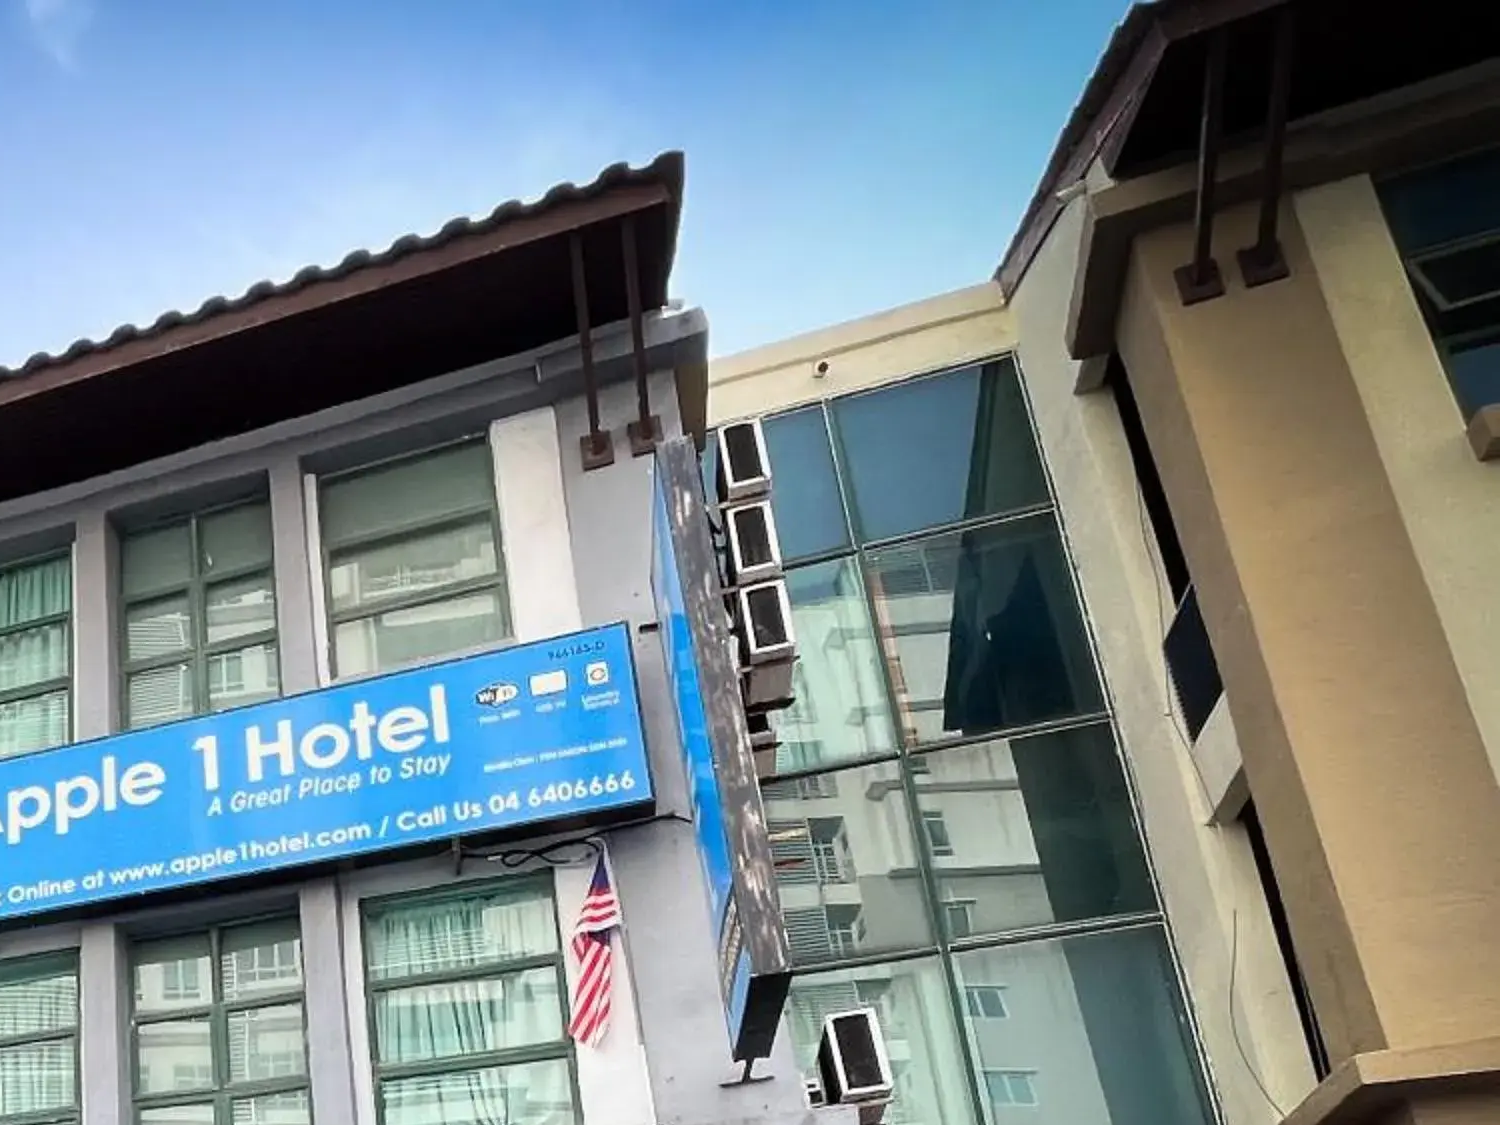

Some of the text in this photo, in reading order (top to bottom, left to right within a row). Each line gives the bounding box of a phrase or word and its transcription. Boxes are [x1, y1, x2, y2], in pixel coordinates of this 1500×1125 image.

[191, 735, 220, 791] 1
[245, 684, 451, 783] Hotel
[207, 796, 223, 817] A
[230, 784, 292, 814] Great
[298, 772, 362, 801] Place
[370, 763, 392, 785] to
[399, 752, 452, 781] Stay
[7, 876, 77, 905] Online
[82, 868, 105, 890] at
[108, 822, 373, 887] www.apple1hotel.com
[377, 815, 390, 839] /
[396, 804, 447, 832] Call
[453, 800, 484, 821] Us
[488, 790, 520, 815] 04
[527, 769, 637, 808] 6406666
